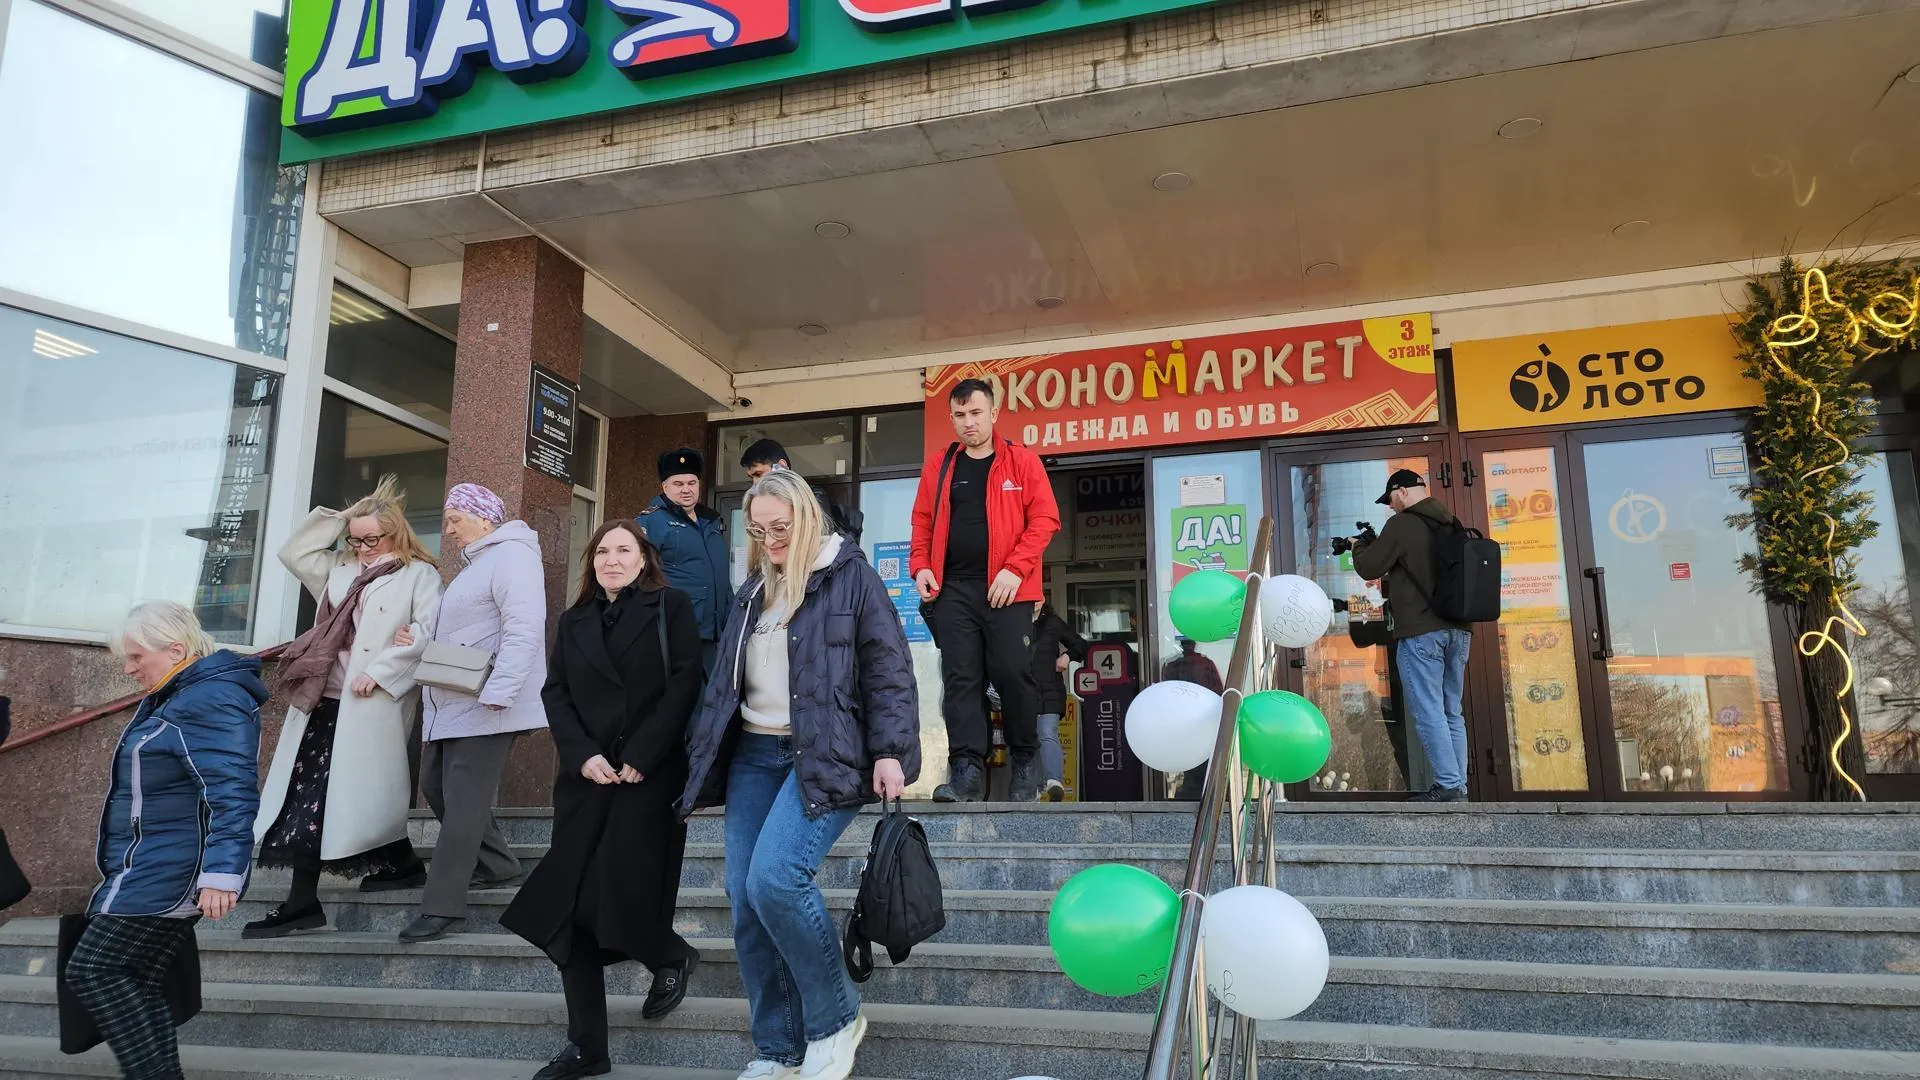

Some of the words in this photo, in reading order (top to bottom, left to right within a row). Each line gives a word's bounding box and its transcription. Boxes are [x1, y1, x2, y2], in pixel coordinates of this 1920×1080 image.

[1400, 319, 1415, 341] 3
[1388, 343, 1431, 360] этаж
[1579, 348, 1665, 378] СТО
[1582, 375, 1705, 410] ЛОТО
[1022, 415, 1149, 447] ОДЕЖДА
[1163, 411, 1180, 433] И
[1195, 401, 1300, 430] ОБУВЬ
[1491, 466, 1548, 476] СПОРТЛОТО
[1085, 512, 1141, 528] ОЧКИ
[1176, 514, 1242, 551] ДА!
[1101, 654, 1114, 670] 4
[1097, 699, 1115, 771] familia
